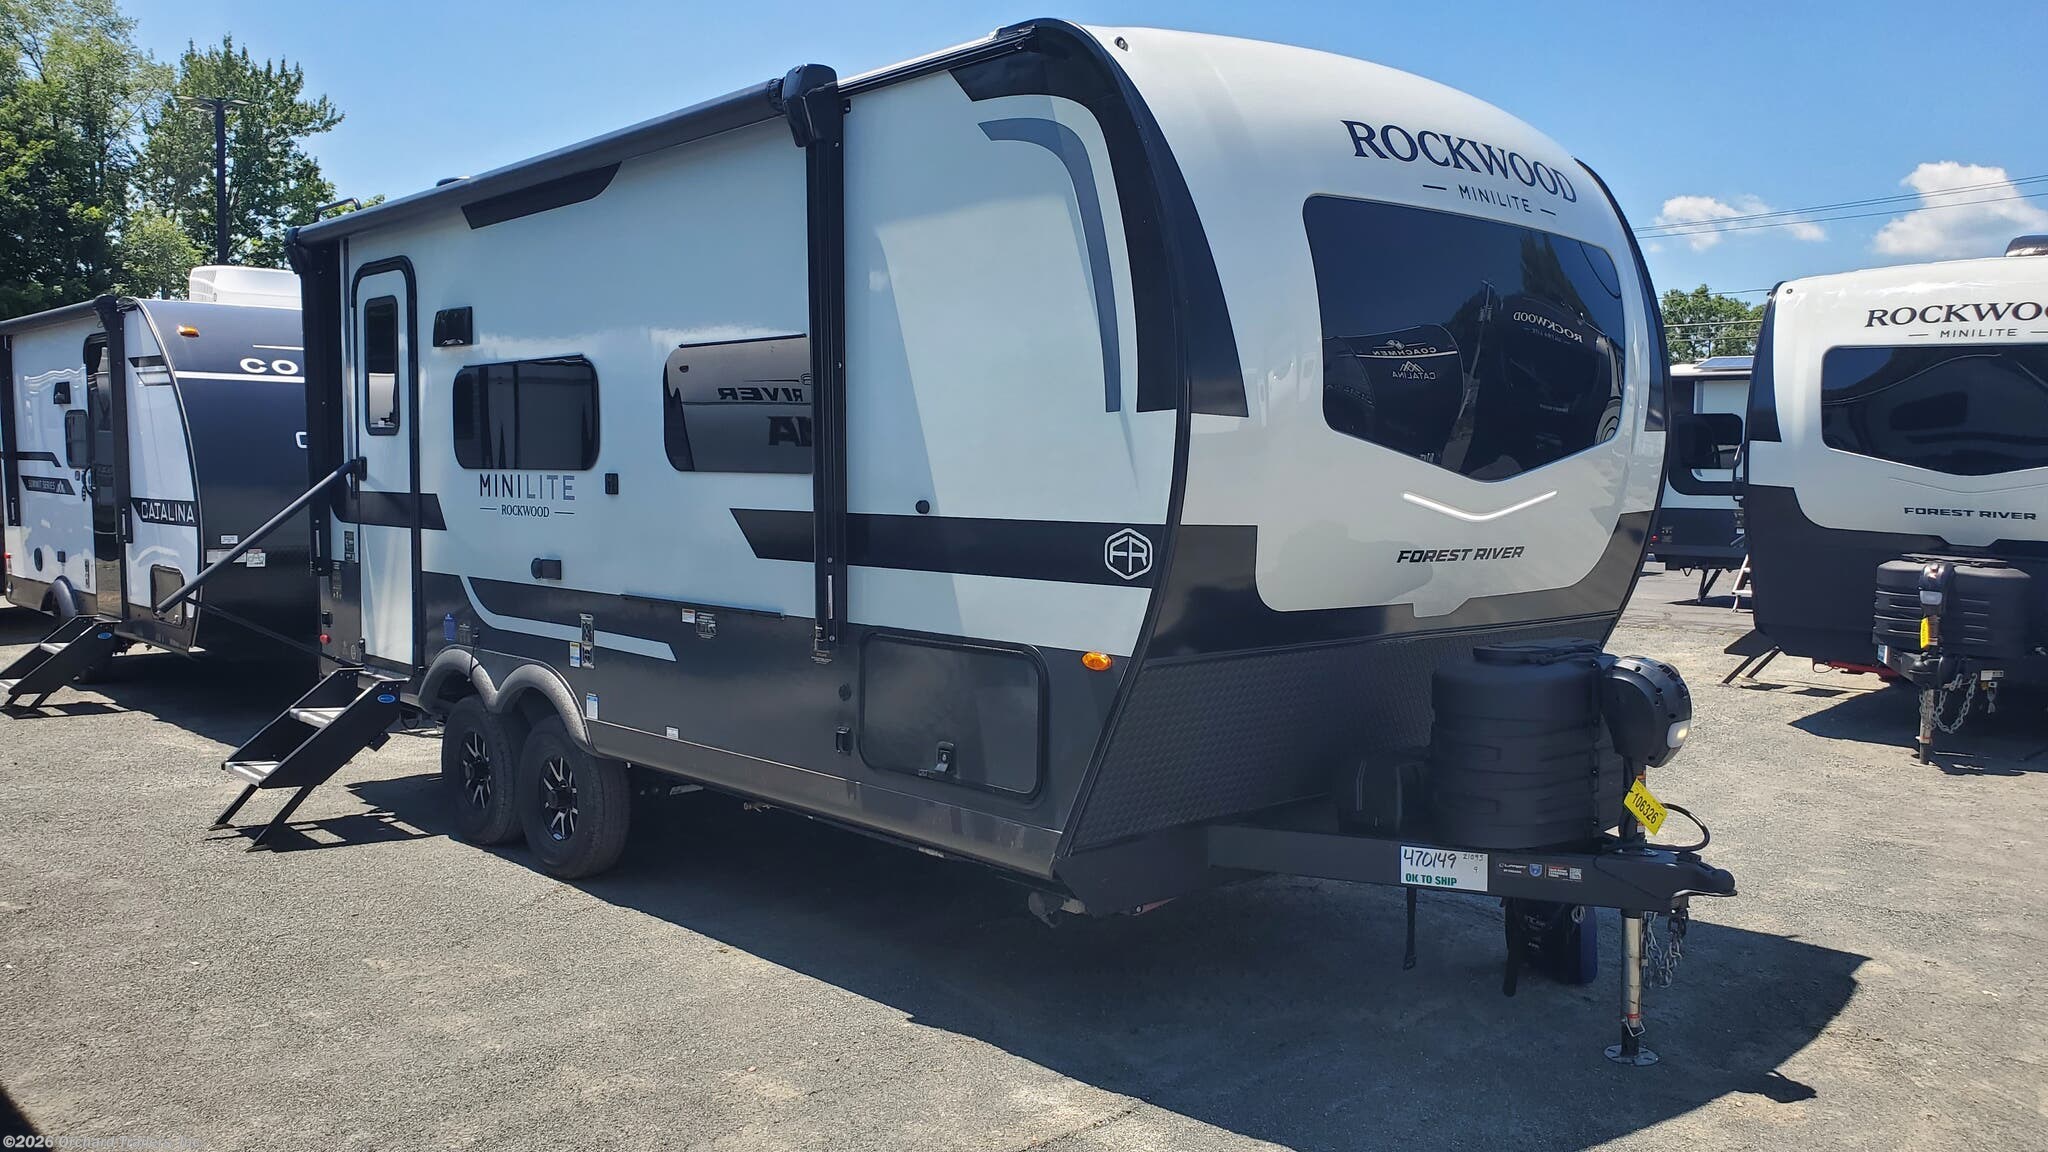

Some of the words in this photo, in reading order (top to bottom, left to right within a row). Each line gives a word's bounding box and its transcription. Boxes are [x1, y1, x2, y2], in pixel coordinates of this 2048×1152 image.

[1339, 119, 1577, 203] ROCKWOOD
[1458, 184, 1532, 213] MINILITE
[1940, 328, 2018, 338] MINILITE
[479, 473, 575, 501] MINILITE
[141, 501, 195, 523] CATALINA
[501, 504, 550, 518] ROCKWOOD
[1903, 506, 1975, 518] FOREST
[1978, 510, 2037, 521] RIVER
[1397, 548, 1473, 563] FOREST
[1473, 546, 1525, 561] RIVER
[1632, 792, 1659, 824] 106326
[1403, 848, 1457, 869] 470149
[1405, 873, 1419, 883] OK
[1420, 874, 1433, 884] TO
[1435, 875, 1458, 886] SHIP
